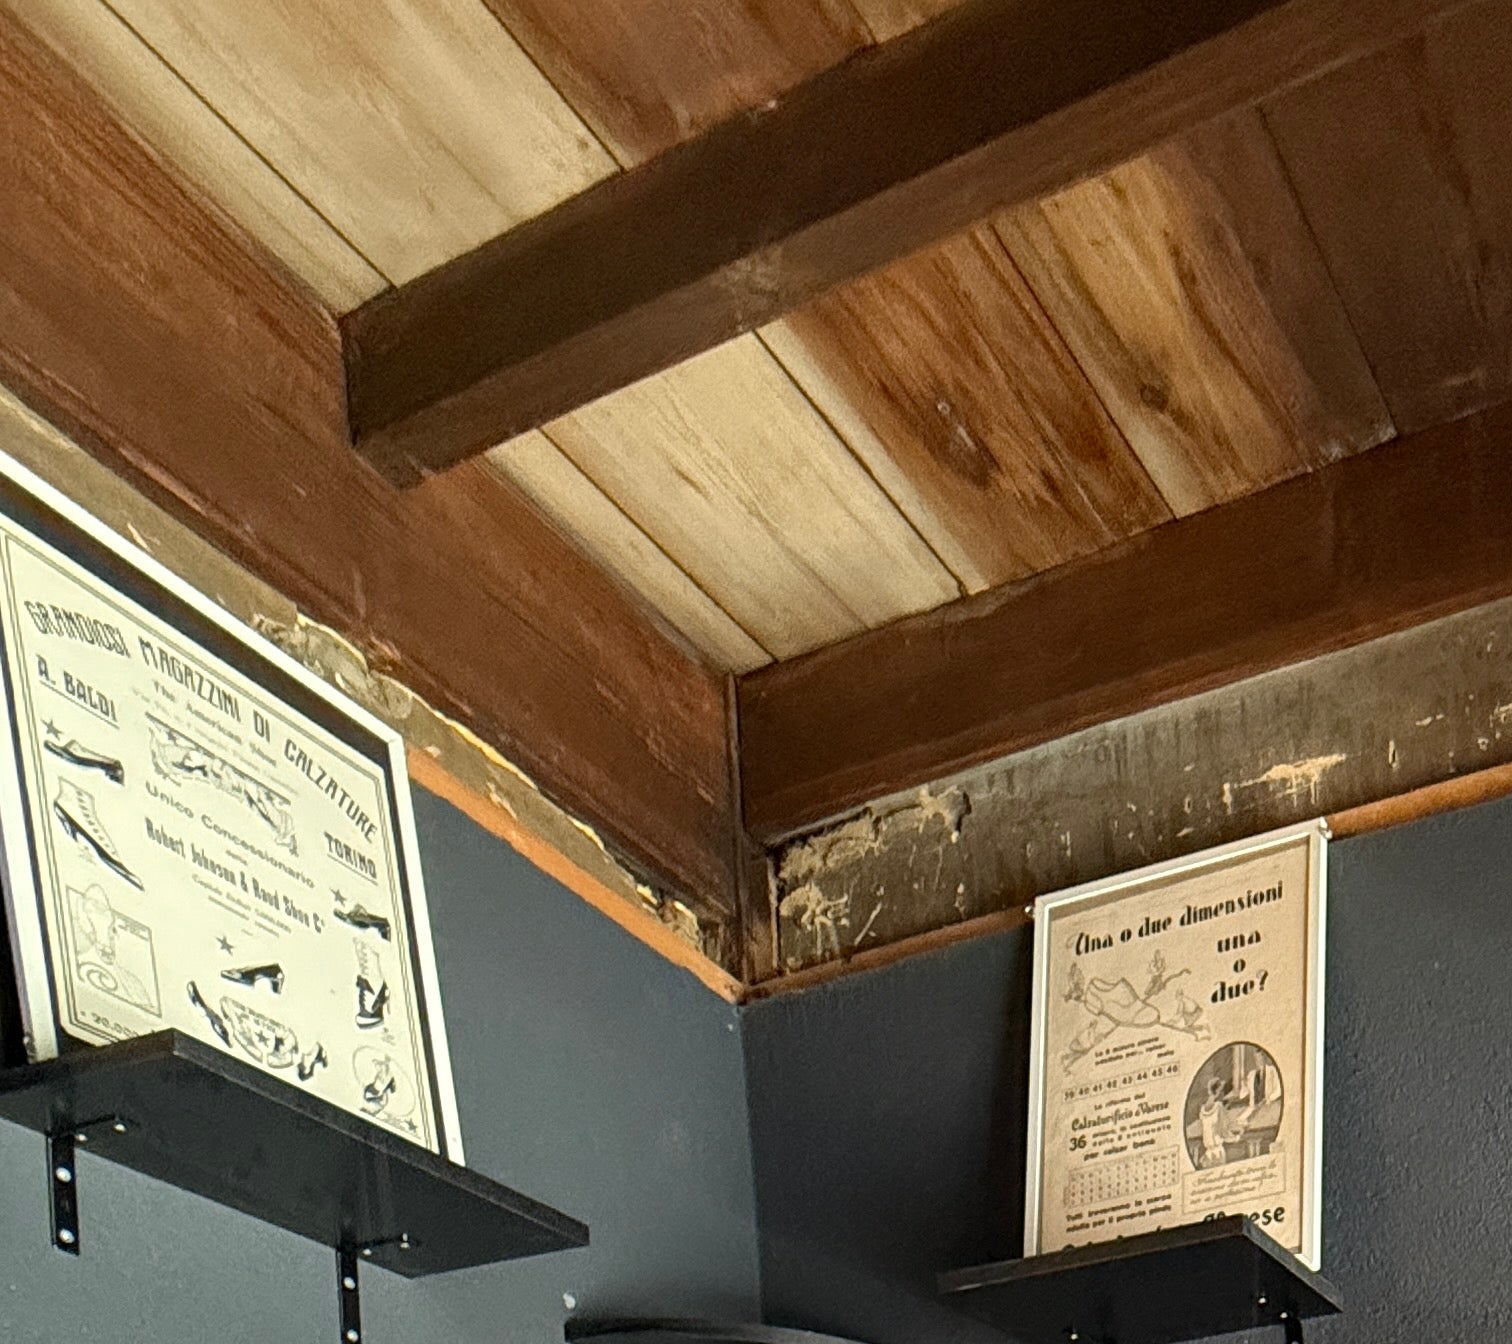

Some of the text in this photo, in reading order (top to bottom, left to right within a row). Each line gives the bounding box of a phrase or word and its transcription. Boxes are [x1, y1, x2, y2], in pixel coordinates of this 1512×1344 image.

[63, 669, 119, 722] BALDI
[138, 635, 242, 723] MAGAZZINI
[253, 709, 271, 743] DI
[284, 738, 378, 844] CALZATURE
[145, 781, 315, 889] Unico Concessionario
[324, 831, 378, 879] TORINO
[1075, 879, 1283, 956] Una o due dimensioni
[1217, 930, 1262, 954] una
[1233, 958, 1247, 974] o
[1211, 968, 1268, 1004] due?
[1069, 1134, 1087, 1152] 36
